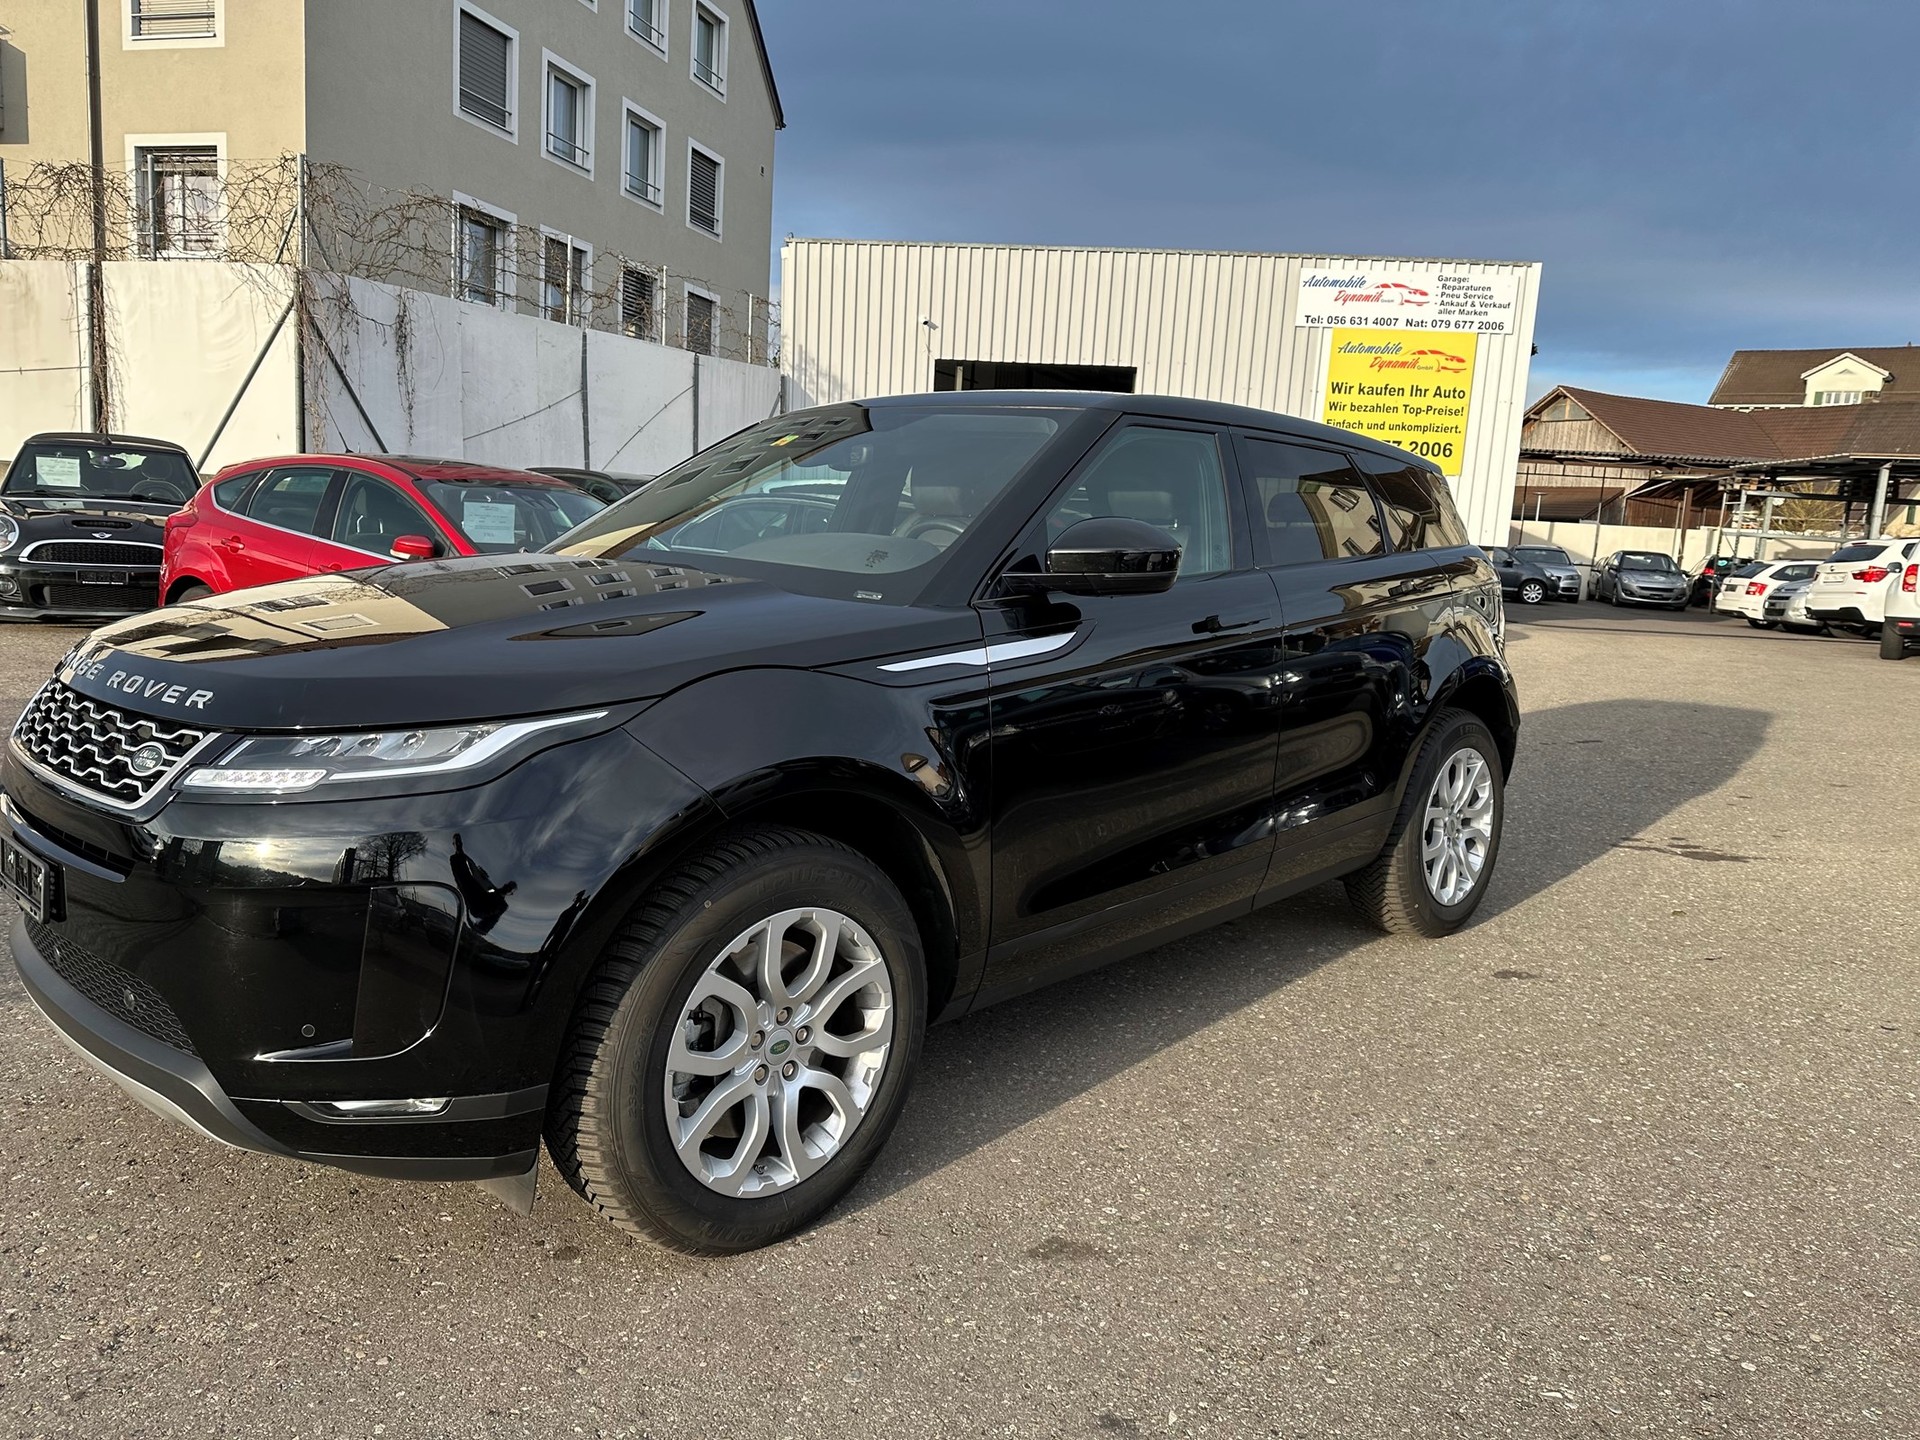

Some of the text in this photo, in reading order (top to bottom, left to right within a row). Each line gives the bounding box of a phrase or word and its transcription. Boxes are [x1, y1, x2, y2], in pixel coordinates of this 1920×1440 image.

[1302, 275, 1367, 288] Automobile
[1438, 275, 1469, 284] Garage:
[1440, 291, 1461, 300] Pneu
[1441, 283, 1492, 293] Reparaturen
[1334, 290, 1384, 305] Dynamik
[1479, 301, 1511, 309] Verkauf
[1437, 308, 1488, 317] aller Marken
[1304, 315, 1505, 331] Tel: 056 631 4007 Nat: 079 677 2006
[1337, 341, 1403, 355] Automobile
[1369, 356, 1421, 373] Dynamik
[1331, 381, 1466, 399] Wir kaufen Ihr Auto
[1328, 401, 1464, 417] Wir bezahlen Top-Preise!
[1326, 419, 1462, 435] Einfach und unkompliziert.
[1408, 441, 1453, 458] 2006
[106, 670, 214, 709] ROVER
